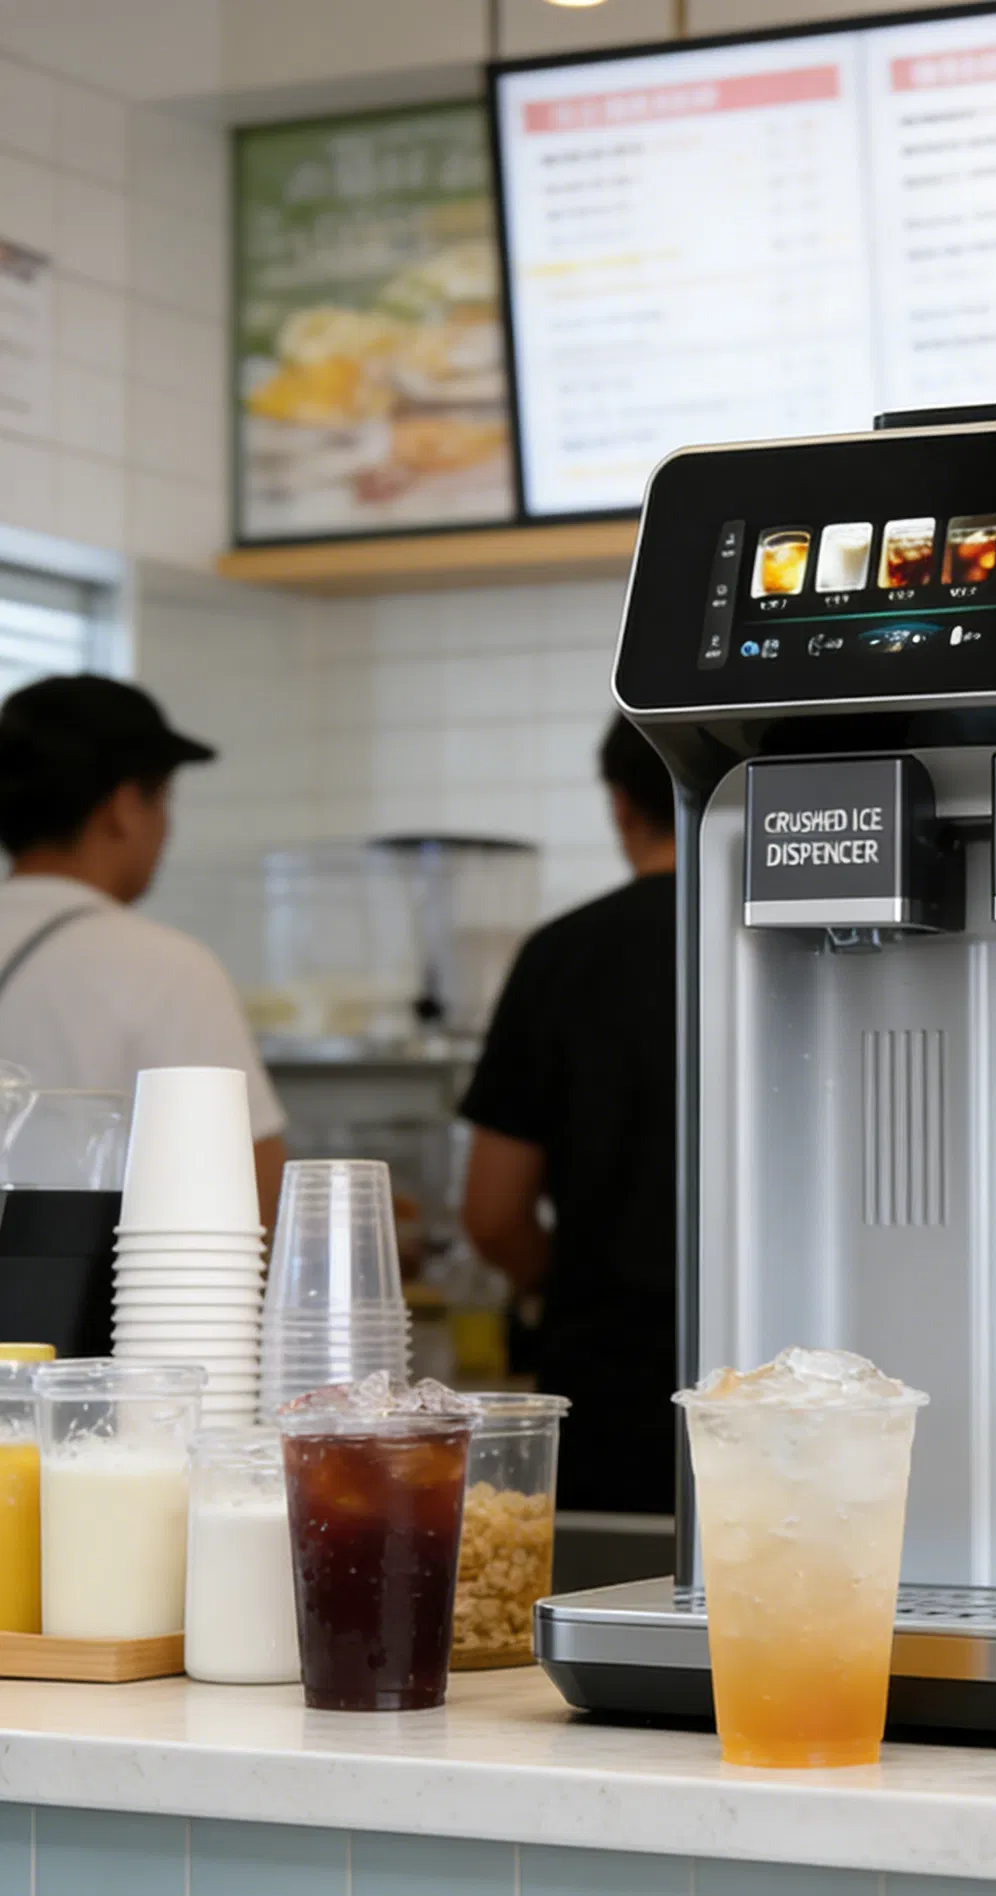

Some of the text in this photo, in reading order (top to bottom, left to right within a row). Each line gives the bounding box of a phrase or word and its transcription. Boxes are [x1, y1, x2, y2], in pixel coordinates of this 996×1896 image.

[764, 806, 884, 833] CRUSHED ICE
[766, 839, 879, 867] DISPENCER
